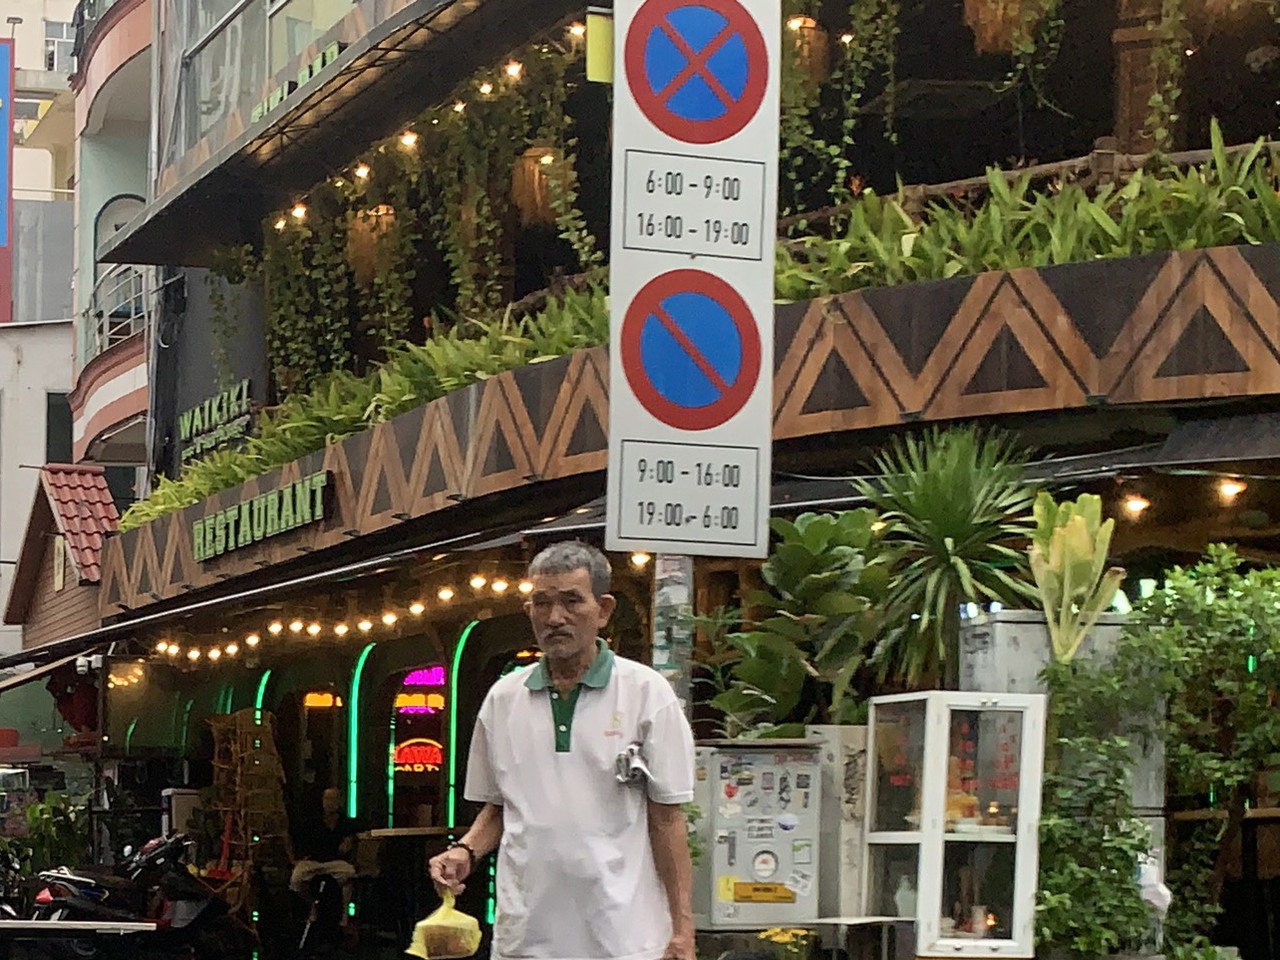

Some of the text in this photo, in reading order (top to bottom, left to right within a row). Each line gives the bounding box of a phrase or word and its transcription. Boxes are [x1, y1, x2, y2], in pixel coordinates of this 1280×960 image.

[646, 170, 683, 195] 6:00
[704, 175, 740, 201] 9:00
[637, 213, 683, 238] 16:00
[704, 219, 749, 245] 19:00
[638, 459, 674, 483] 9:00
[696, 462, 740, 488] 16:00
[193, 471, 327, 560] RESTAURANT
[638, 501, 683, 527] 19:00
[702, 505, 739, 529] 6:00
